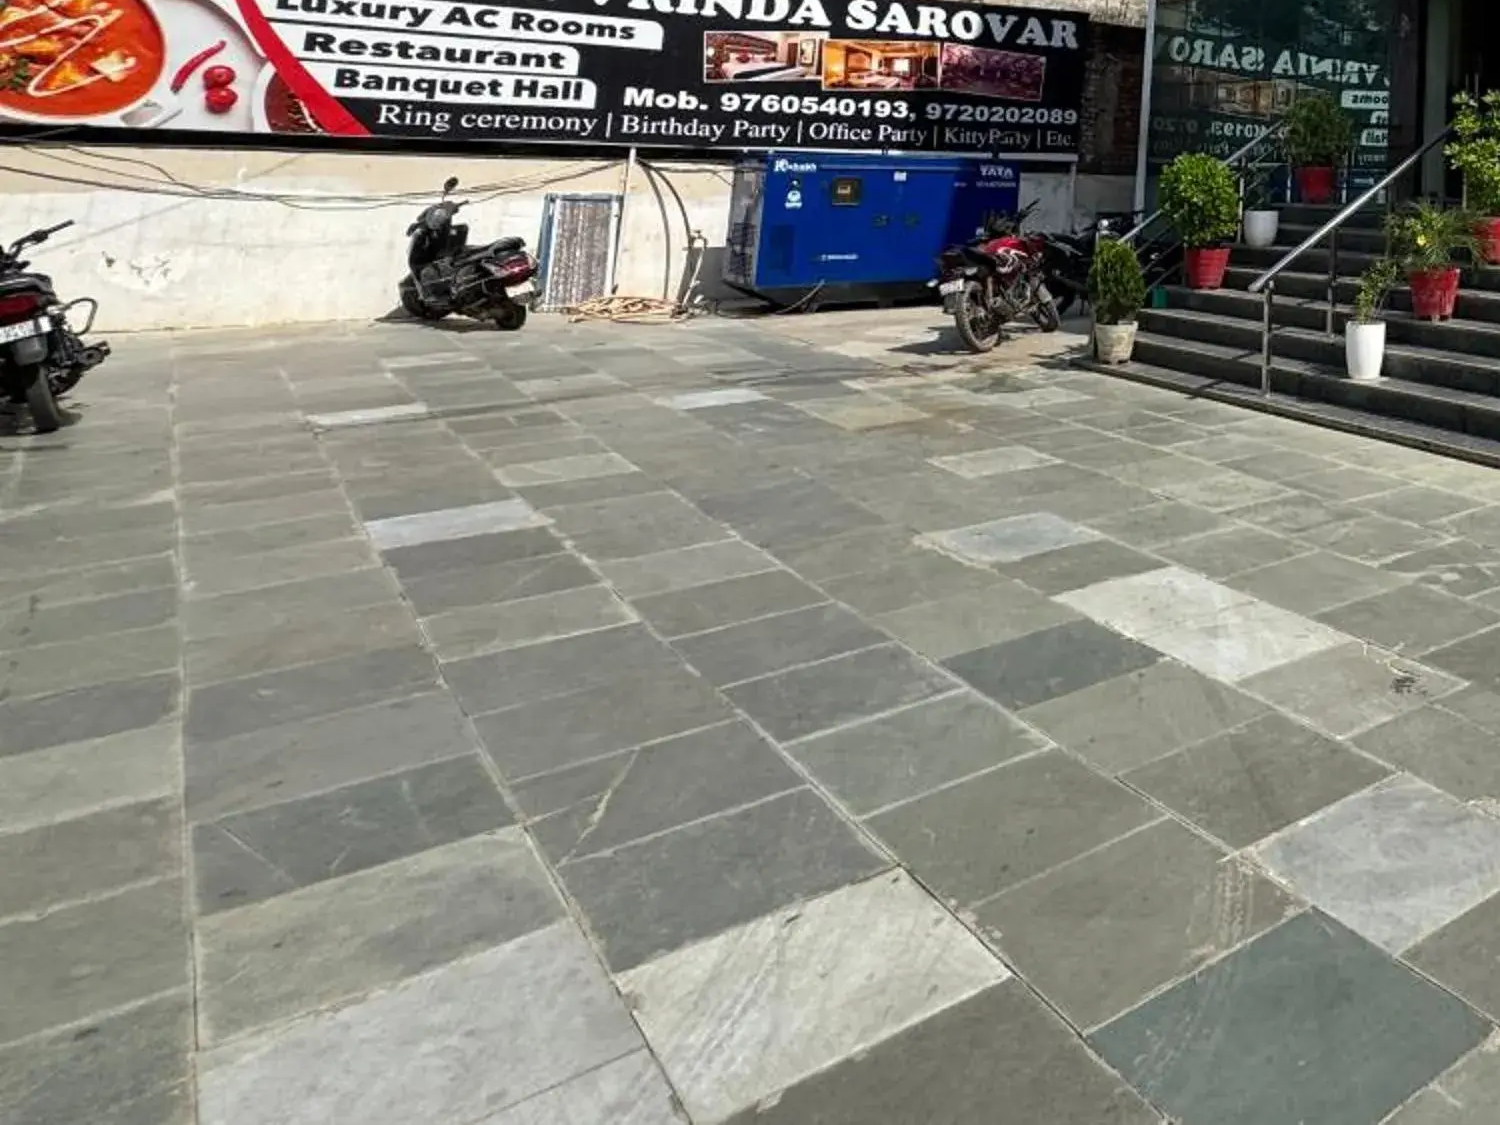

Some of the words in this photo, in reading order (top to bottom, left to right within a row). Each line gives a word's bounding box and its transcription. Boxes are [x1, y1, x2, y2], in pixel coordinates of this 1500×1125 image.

[442, 6, 500, 29] AC
[511, 12, 636, 41] Rooms
[845, 0, 1078, 48] SAROVAR
[303, 31, 567, 71] Restaurant
[334, 69, 504, 101] Banquet
[513, 78, 583, 101] Hall
[378, 103, 452, 132] Ring
[460, 108, 597, 136] ceremony
[620, 115, 725, 139] Birthday
[733, 120, 790, 142] Party
[809, 122, 871, 142] Office
[878, 125, 926, 146] Party
[1046, 131, 1076, 148] Etc.
[624, 87, 708, 111] Mob.
[720, 92, 917, 122] 9760540193,
[926, 103, 1078, 125] 9720202089
